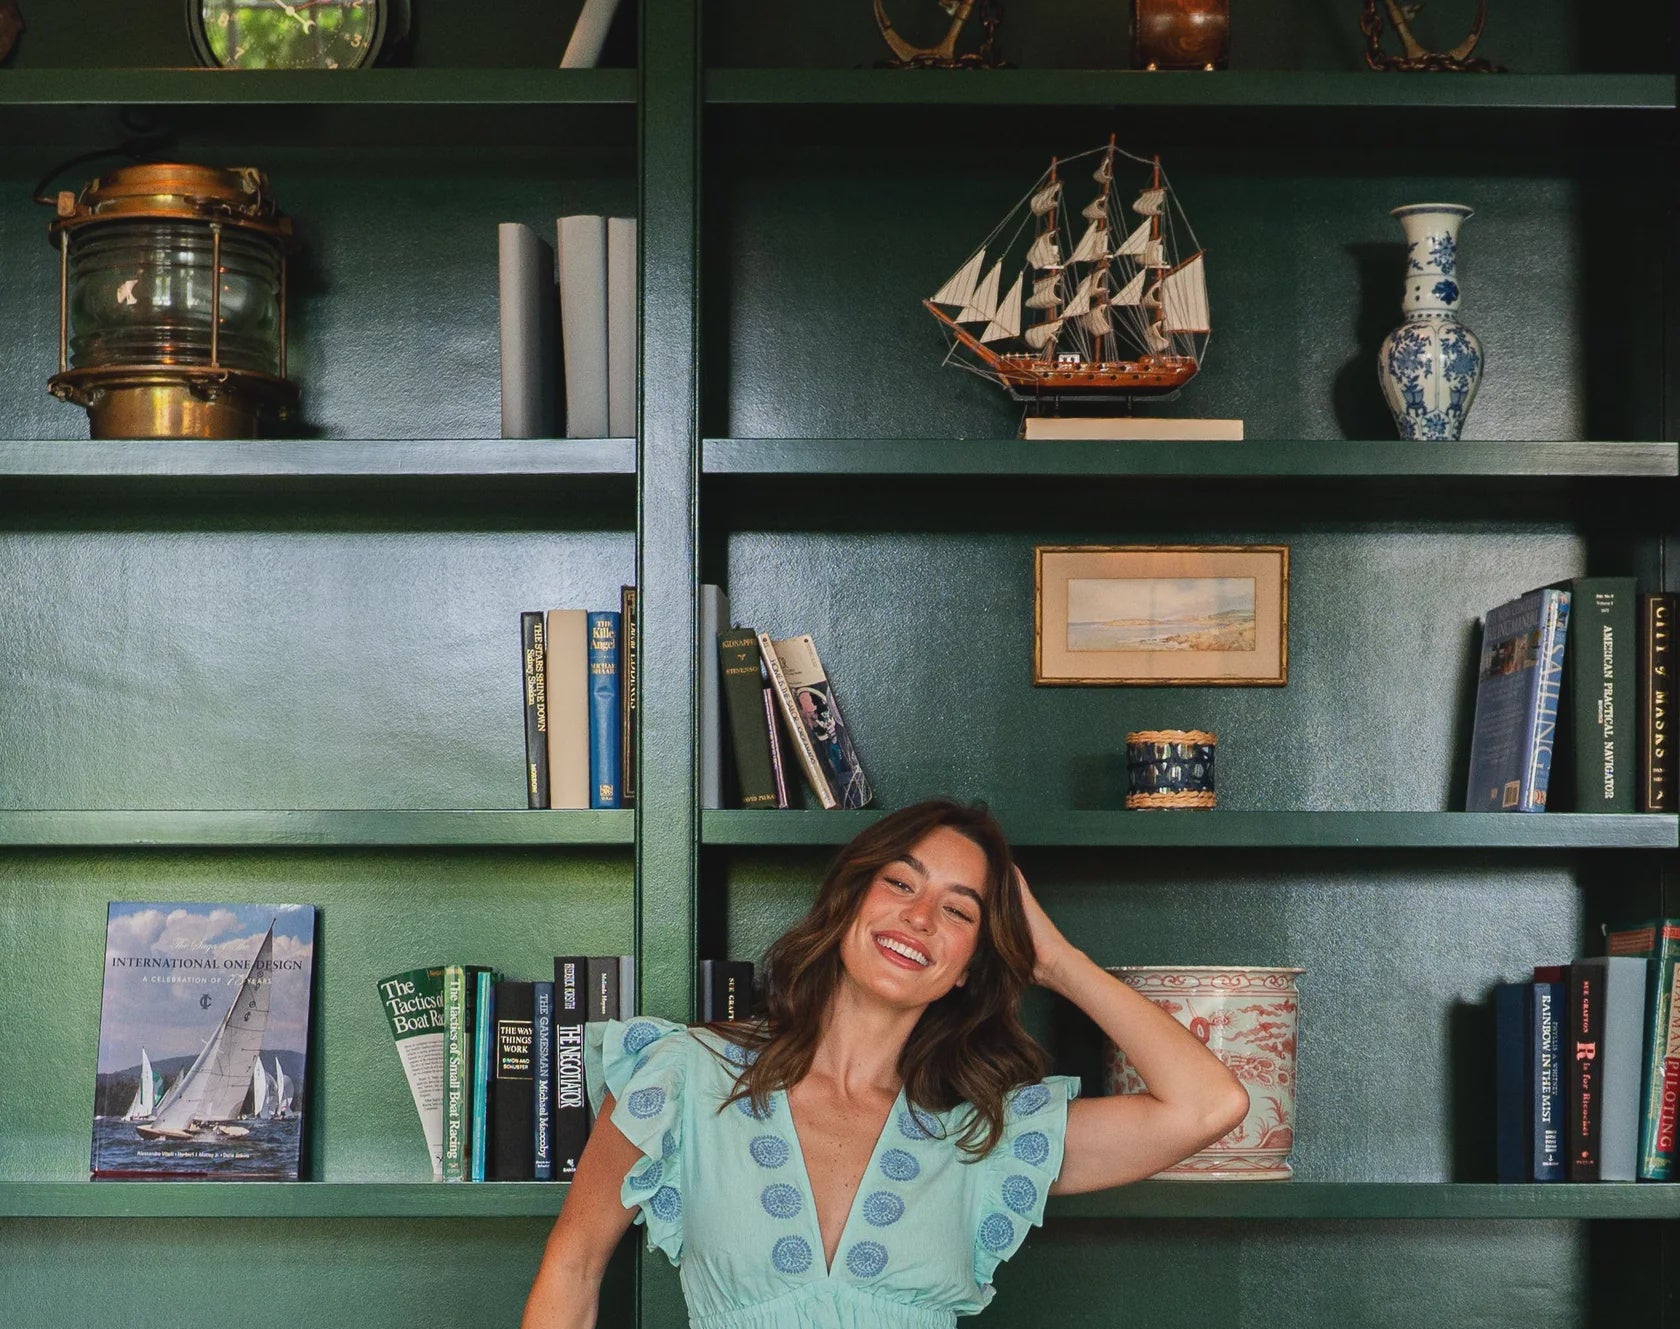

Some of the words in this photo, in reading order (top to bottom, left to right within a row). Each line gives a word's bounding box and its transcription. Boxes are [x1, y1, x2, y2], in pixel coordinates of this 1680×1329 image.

[534, 623, 542, 642] THE
[526, 649, 535, 675] Sidney
[535, 643, 544, 671] STARS
[1603, 625, 1614, 678] AMERICAN
[536, 673, 545, 702] SHINE
[538, 703, 546, 732] DOWN
[1532, 644, 1565, 770] SAILING
[1604, 682, 1614, 738] PRACTICAL
[1604, 741, 1614, 799] NAVIGATOR
[112, 957, 220, 970] INTERNATIONAL
[223, 959, 250, 969] ONE
[256, 960, 303, 970] DESIGN
[151, 976, 207, 984] CELEBRATION
[210, 976, 221, 984] OF
[380, 978, 416, 1000] The
[450, 980, 461, 1001] The
[386, 993, 437, 1017] Tactics
[539, 994, 548, 1015] THE
[392, 1013, 429, 1034] Boat
[450, 1003, 461, 1040] Tactics
[500, 1027, 517, 1035] THE
[517, 1027, 533, 1035] WAY
[1542, 995, 1551, 1051] RAINBOW
[501, 1036, 532, 1044] THINGS
[538, 1018, 549, 1077] GAMESMAN
[560, 1026, 581, 1044] THE
[450, 1042, 461, 1055] of
[503, 1045, 529, 1053] WORK
[1542, 1054, 1551, 1067] IN
[1577, 1041, 1596, 1061] R
[450, 1057, 460, 1088] Small
[560, 1047, 582, 1108] NEGOTIATOR
[1542, 1070, 1551, 1093] THE
[1582, 1073, 1591, 1089] for
[449, 1091, 460, 1117] Boat
[538, 1079, 549, 1116] Michael
[1542, 1094, 1551, 1123] MIST
[1660, 1059, 1680, 1148] PILOTING
[447, 1119, 460, 1159] Racing
[536, 1118, 550, 1159] Maccoby
